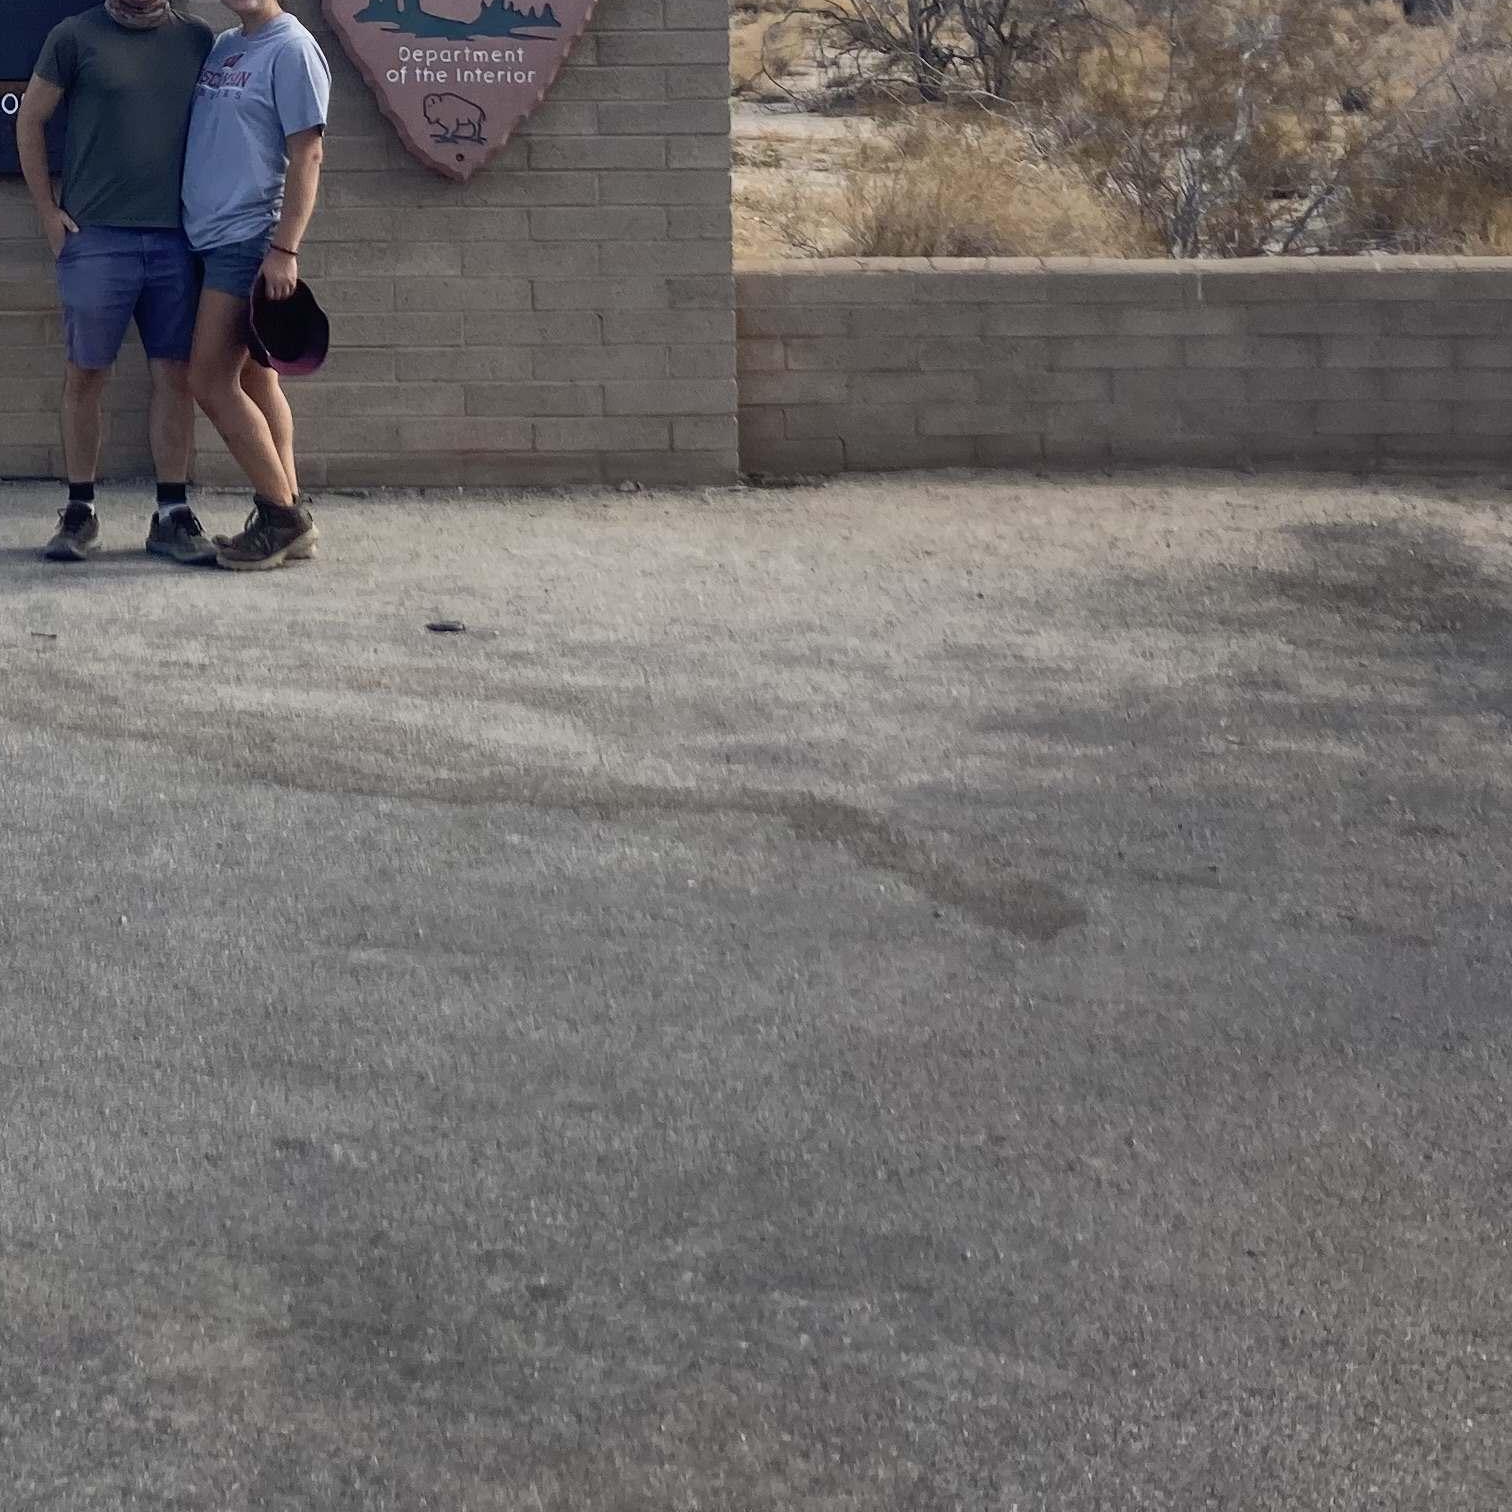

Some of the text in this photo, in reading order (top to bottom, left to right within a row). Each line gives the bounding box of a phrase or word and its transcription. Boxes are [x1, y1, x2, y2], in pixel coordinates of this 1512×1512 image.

[398, 46, 525, 66] Department
[386, 66, 536, 84] of the Interior
